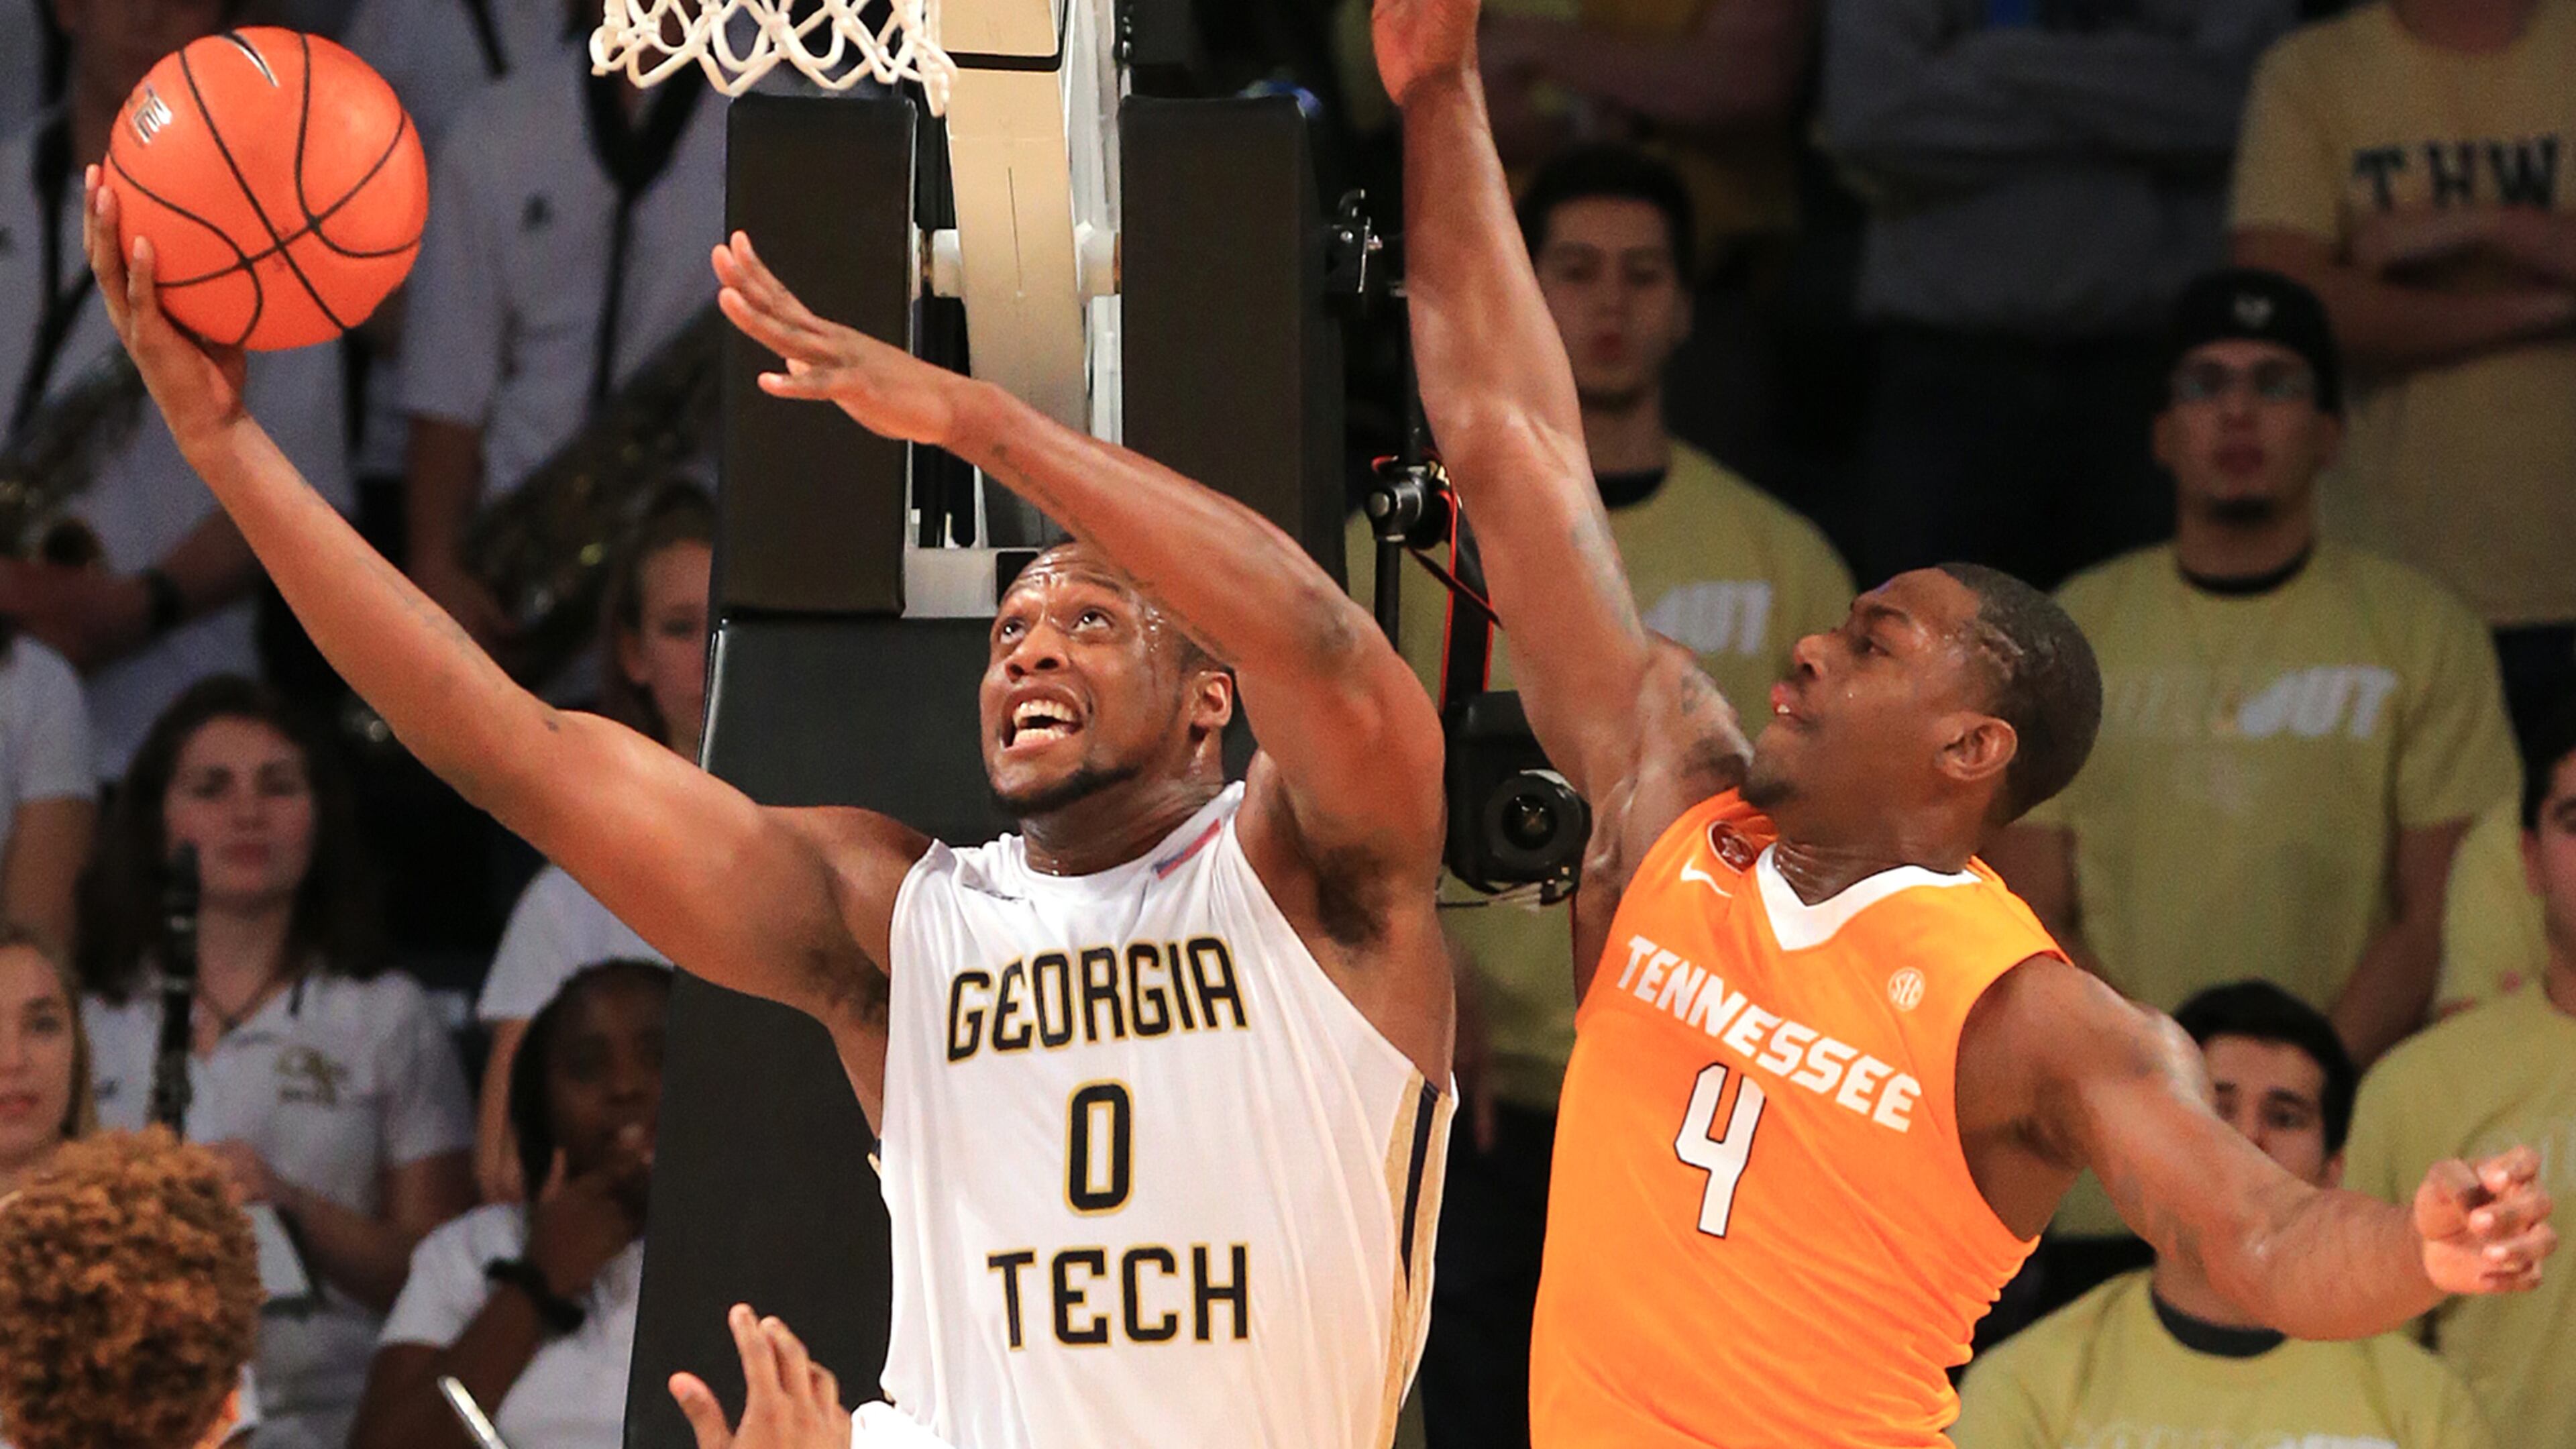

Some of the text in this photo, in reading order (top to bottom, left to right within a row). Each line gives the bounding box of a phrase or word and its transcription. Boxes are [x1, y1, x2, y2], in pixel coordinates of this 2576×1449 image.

[947, 936, 1250, 1063] GEORGIA
[1617, 934, 1923, 1134] TENNESSEE
[1063, 1079, 1134, 1216] 0
[1674, 1062, 1766, 1239] 4
[987, 1242, 1250, 1352] TECH
